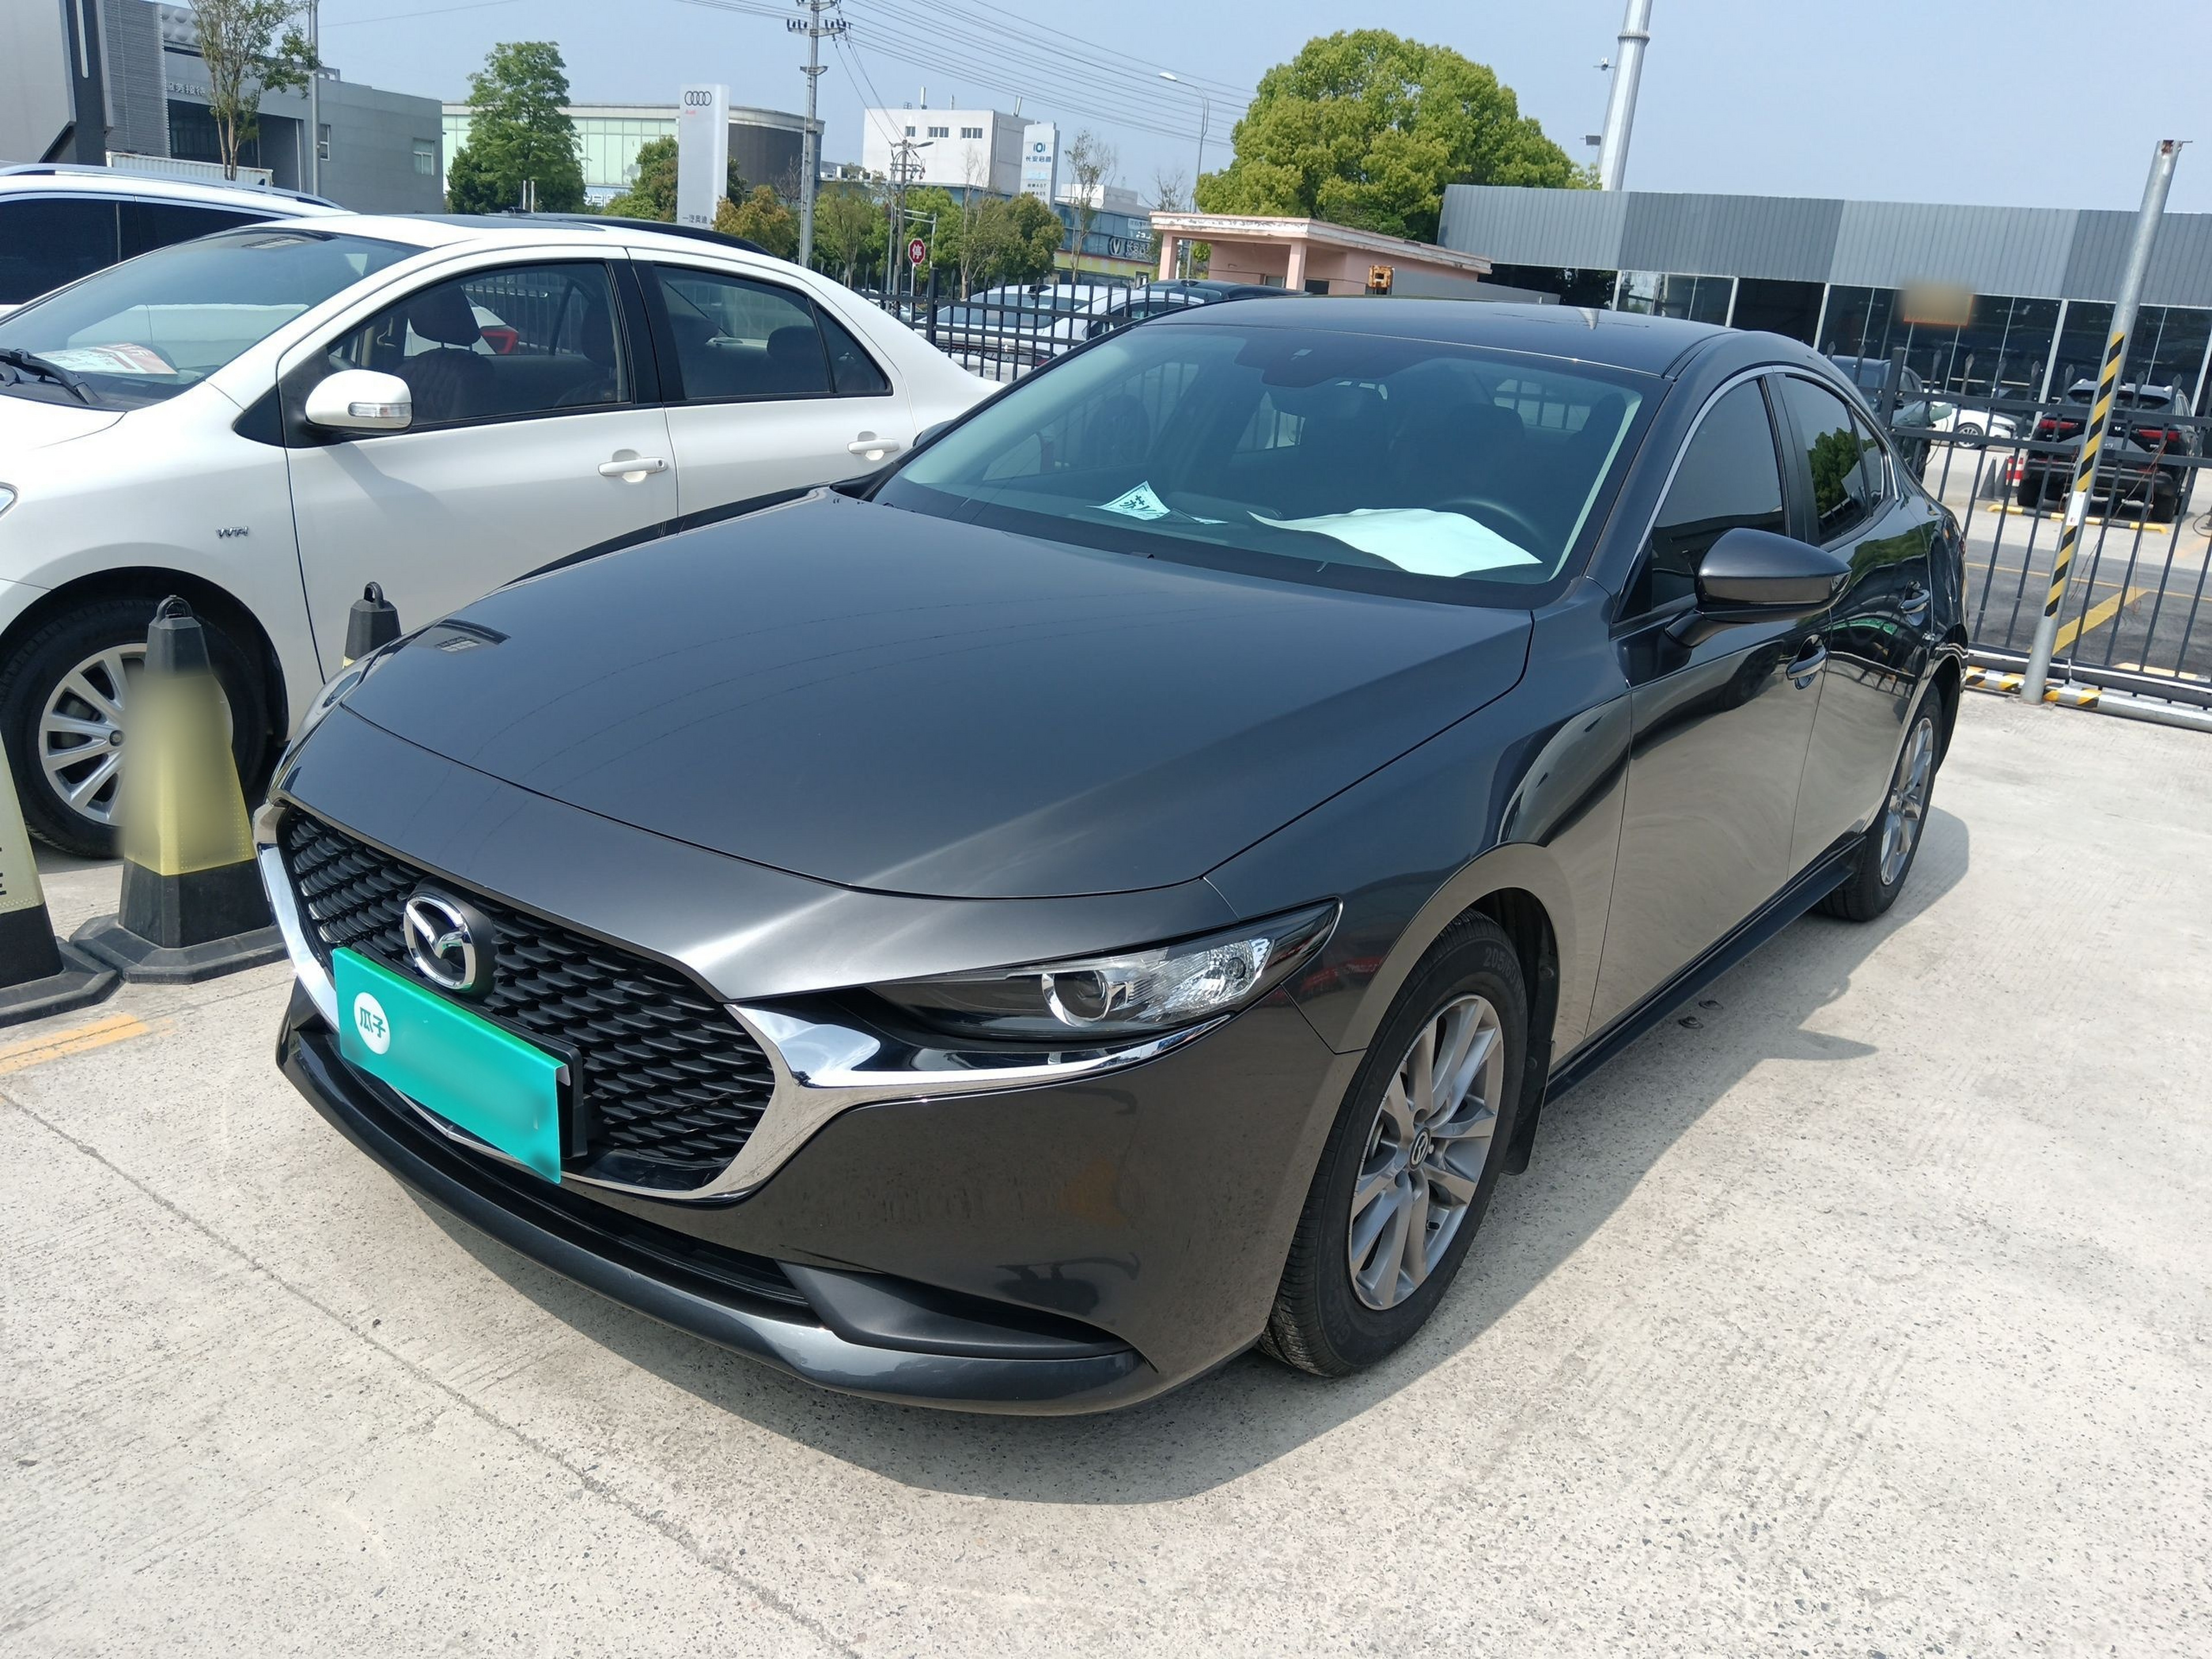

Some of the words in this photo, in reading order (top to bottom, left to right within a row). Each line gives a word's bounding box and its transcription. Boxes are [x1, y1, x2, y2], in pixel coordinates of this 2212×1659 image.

[682, 214, 707, 224] 一汽奥迪
[912, 244, 922, 259] 停
[359, 1006, 386, 1039] 瓜子
